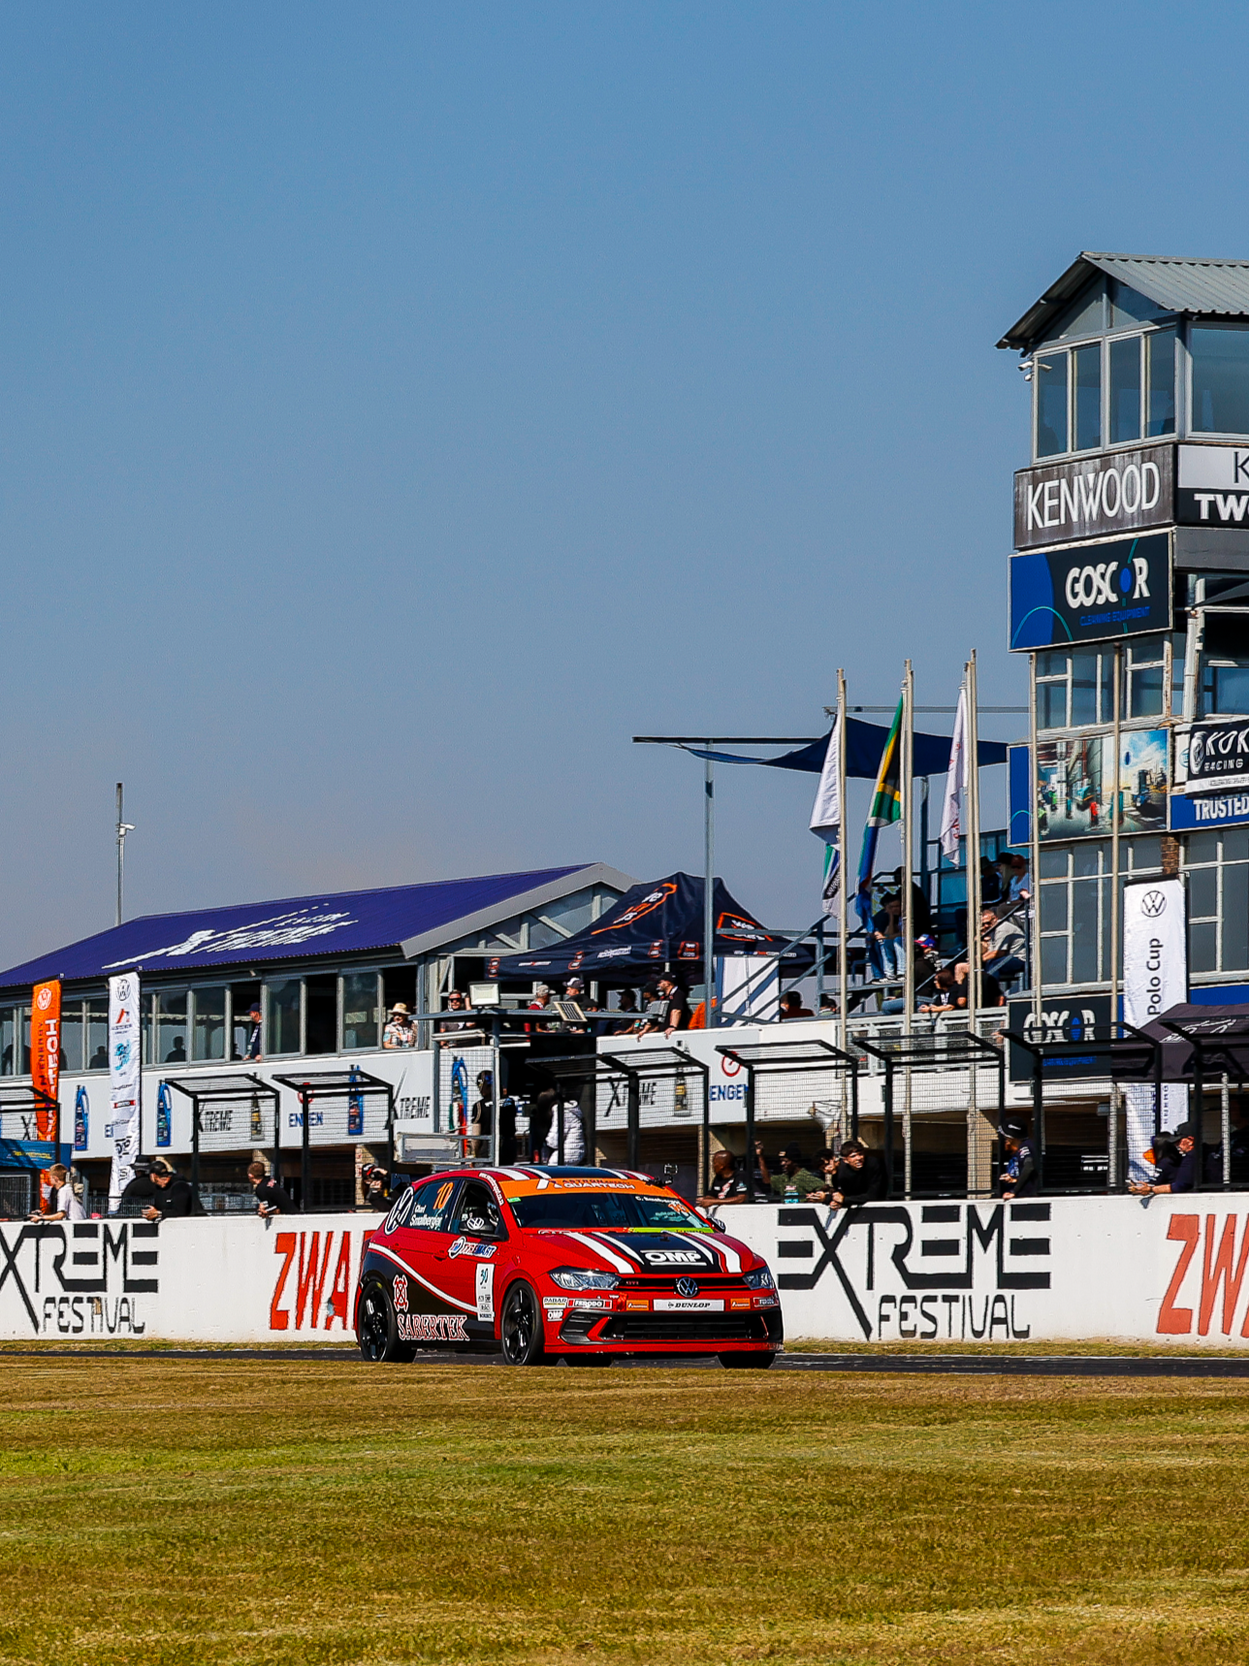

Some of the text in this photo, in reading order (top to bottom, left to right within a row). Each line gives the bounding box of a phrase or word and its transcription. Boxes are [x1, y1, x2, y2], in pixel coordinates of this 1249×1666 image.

[1027, 461, 1160, 531] KENWOOD
[1194, 493, 1249, 522] TW
[1193, 796, 1249, 821] TRUSTED
[1146, 937, 1164, 1016] Polo Cup
[288, 1111, 324, 1128] ENEN
[432, 1181, 454, 1210] 10
[563, 1182, 636, 1190] QUARTECH
[645, 1250, 701, 1263] OMP
[778, 1203, 1050, 1341] EXTREME
[269, 1229, 376, 1332] ZWA
[1156, 1213, 1249, 1338] ZW
[43, 1296, 146, 1335] FESTIVAL
[547, 1311, 564, 1320] OMP
[879, 1294, 1031, 1340] FESTIVAL
